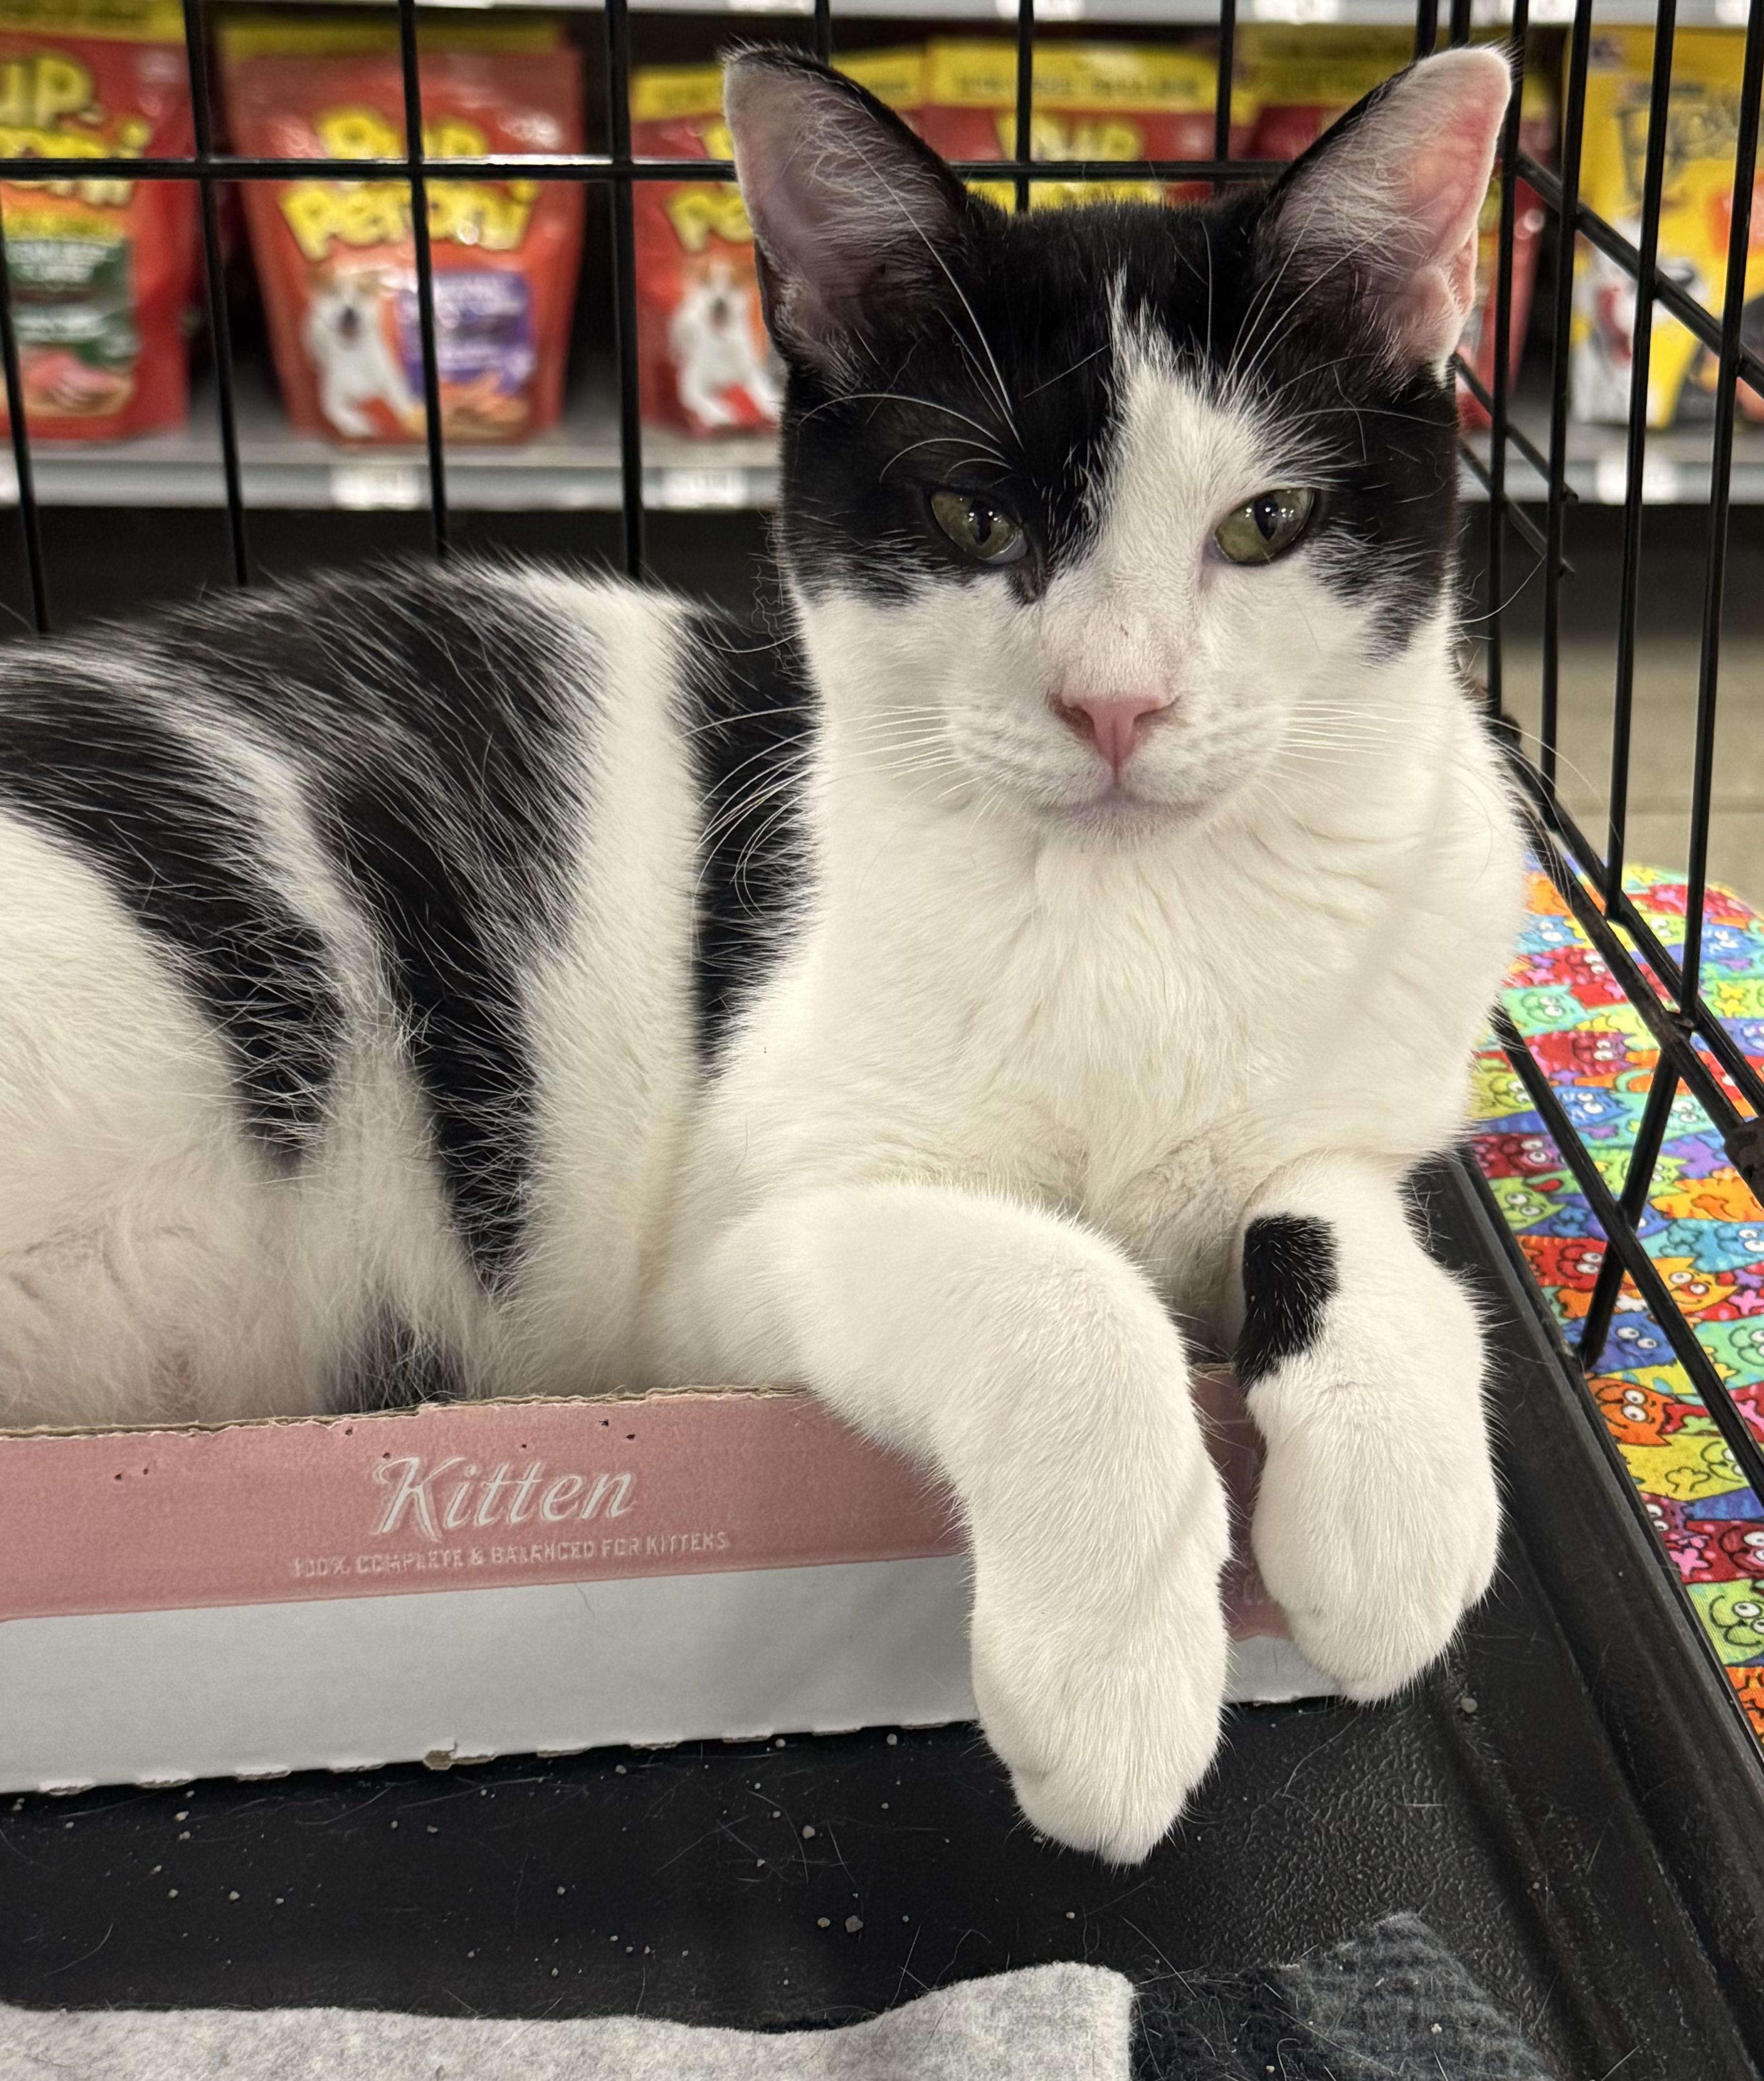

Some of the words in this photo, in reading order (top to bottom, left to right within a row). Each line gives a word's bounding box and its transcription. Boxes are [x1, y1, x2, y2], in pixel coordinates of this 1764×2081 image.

[373, 1454, 636, 1542] Kitten
[293, 1556, 351, 1578] 100%
[355, 1549, 464, 1574] COMPLETE
[470, 1546, 484, 1566] &
[491, 1540, 595, 1564] BALANCED
[600, 1537, 640, 1557] FOR
[646, 1531, 731, 1556] KITTENS
